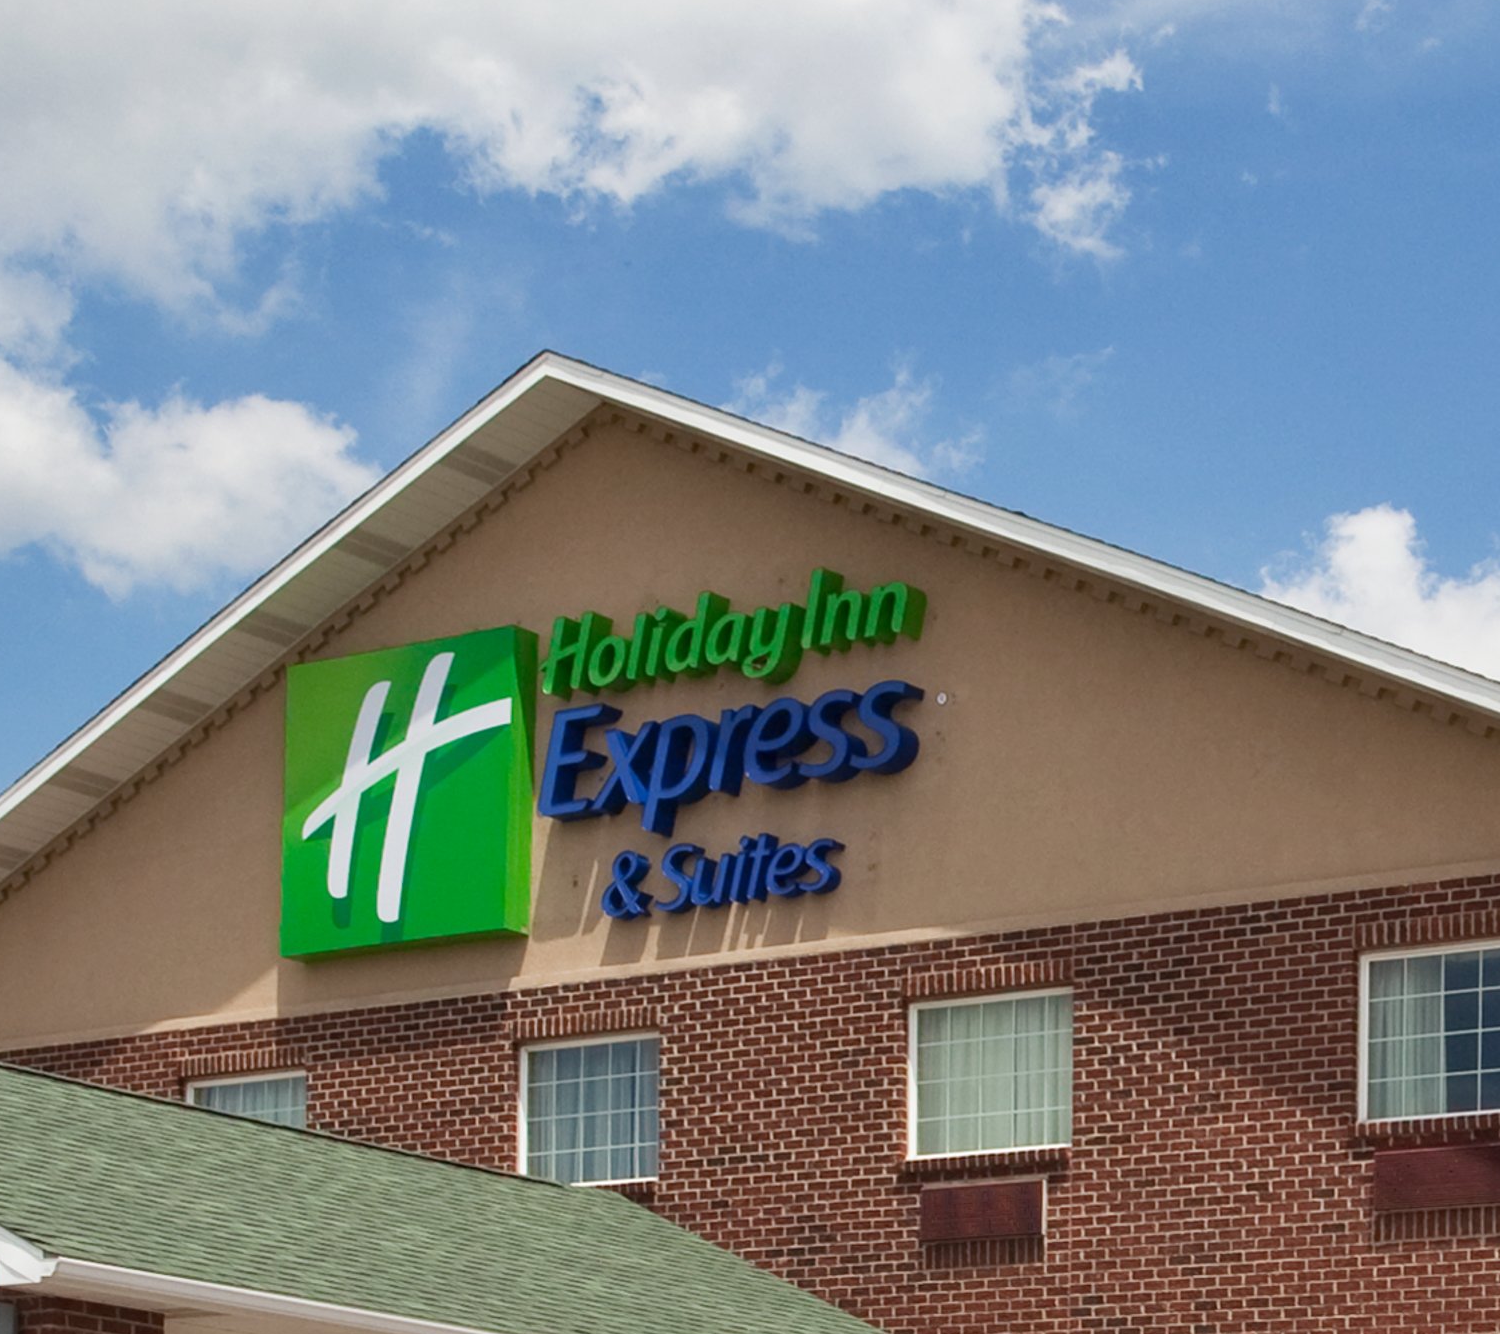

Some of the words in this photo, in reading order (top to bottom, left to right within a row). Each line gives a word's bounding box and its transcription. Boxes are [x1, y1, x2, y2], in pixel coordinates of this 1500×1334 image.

[541, 591, 805, 699] Holiday
[801, 568, 928, 655] Inn
[537, 680, 925, 837] Express
[601, 849, 653, 921] &
[654, 832, 846, 913] Suites
